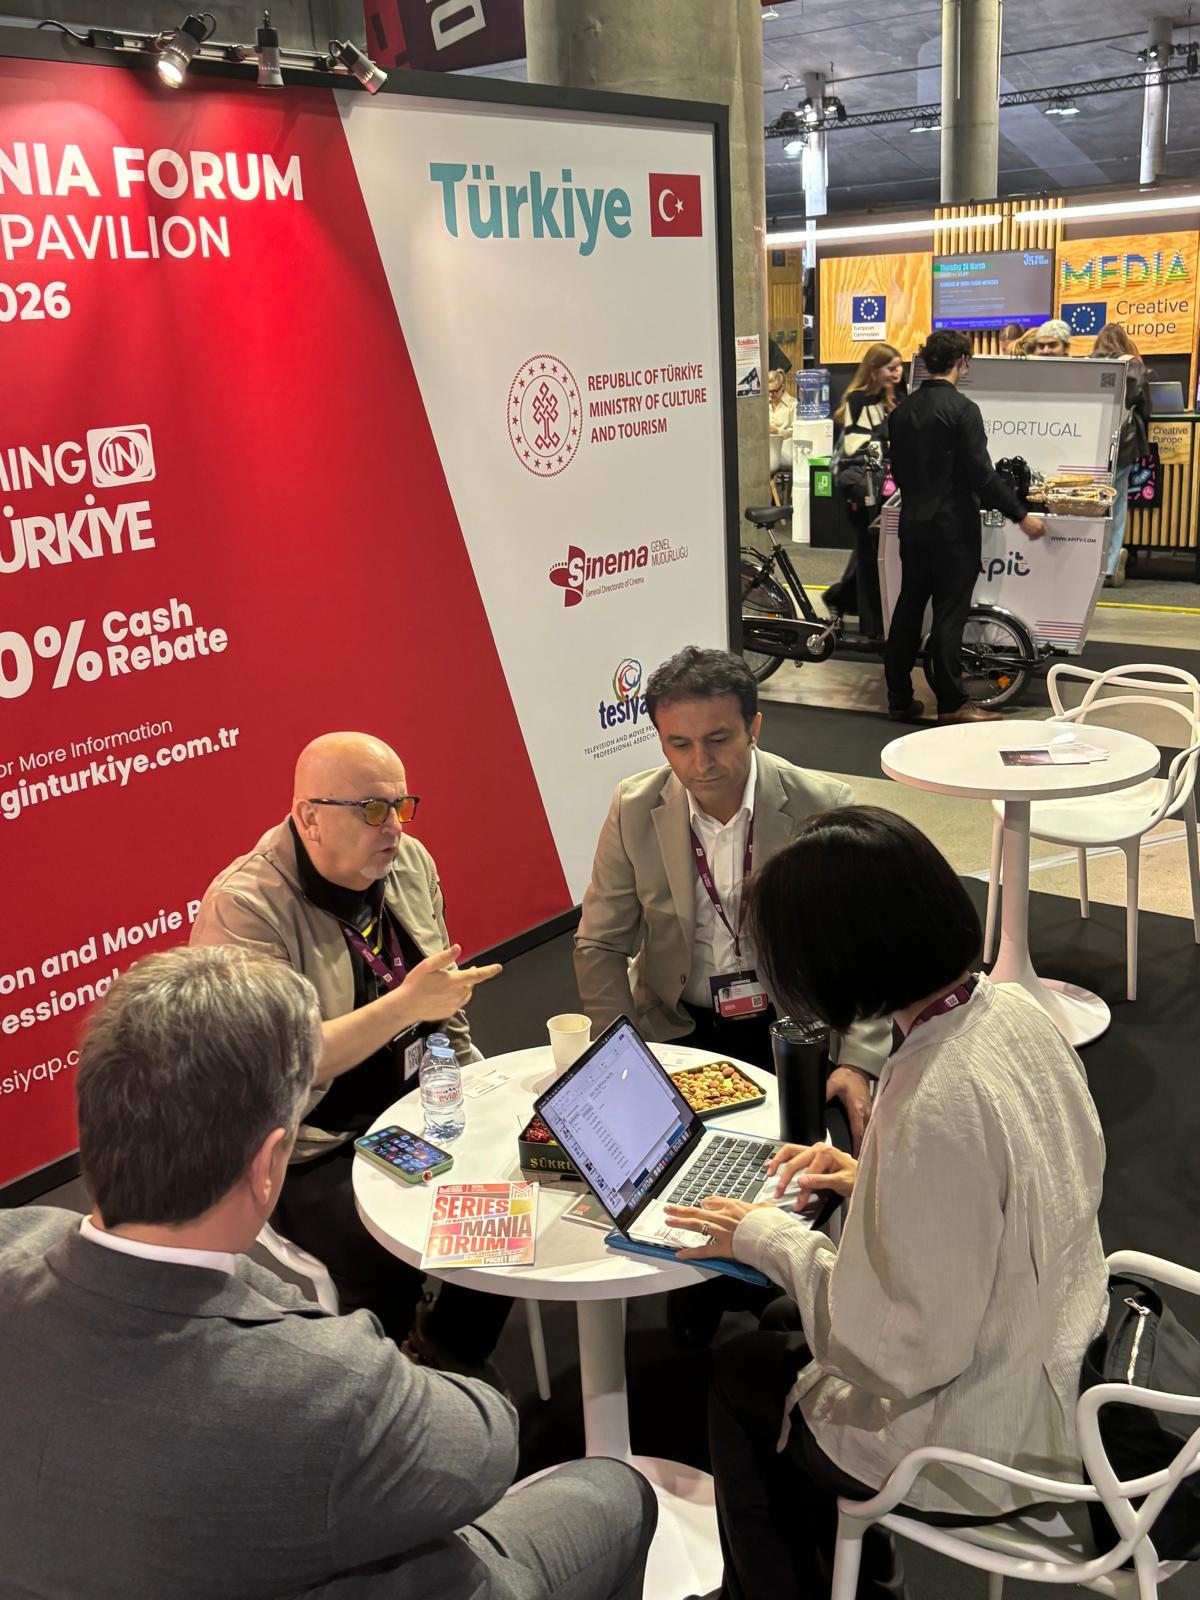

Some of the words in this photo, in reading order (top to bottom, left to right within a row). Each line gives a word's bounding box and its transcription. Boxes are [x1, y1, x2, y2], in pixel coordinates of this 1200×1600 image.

[113, 147, 304, 201] FORUM
[429, 162, 632, 257] Türkiye
[1, 214, 231, 261] PAVILION
[1062, 251, 1192, 292] MEDIA
[1116, 299, 1189, 316] Creative
[588, 371, 642, 392] REPUBLIC
[644, 369, 659, 386] OF
[660, 362, 703, 383] TÜRKİYE
[589, 395, 643, 418] MINISTRY
[646, 393, 660, 411] OF
[661, 387, 707, 408] CULTURE
[590, 426, 616, 444] AND
[617, 418, 668, 440] TOURISM
[992, 420, 1082, 438] PORTUGAL
[1152, 426, 1188, 435] Creative
[0, 441, 87, 492] ING
[651, 538, 671, 553] GENEL
[568, 546, 649, 587] Sinema
[980, 551, 1031, 582] pit
[585, 586, 602, 598] General
[602, 580, 625, 595] Directorate
[629, 576, 645, 588] Cinema
[102, 598, 193, 643] Cash
[0, 620, 103, 699] 0%
[107, 626, 228, 677] Rebate
[19, 748, 67, 772] More
[70, 720, 173, 758] Information
[584, 739, 615, 755] TELEVISION
[616, 734, 628, 744] AND
[628, 728, 645, 739] MOVIE
[593, 742, 633, 760] PROFESSIONAL
[0, 727, 240, 820] ginturkiye.com.tr
[41, 936, 98, 979] and
[102, 909, 183, 956] Movie
[0, 968, 120, 1034] essional
[0, 1050, 80, 1096] siyap.c
[432, 1196, 510, 1222] SERIES
[462, 1213, 532, 1238] MANIA
[426, 1235, 506, 1259] FORUM
